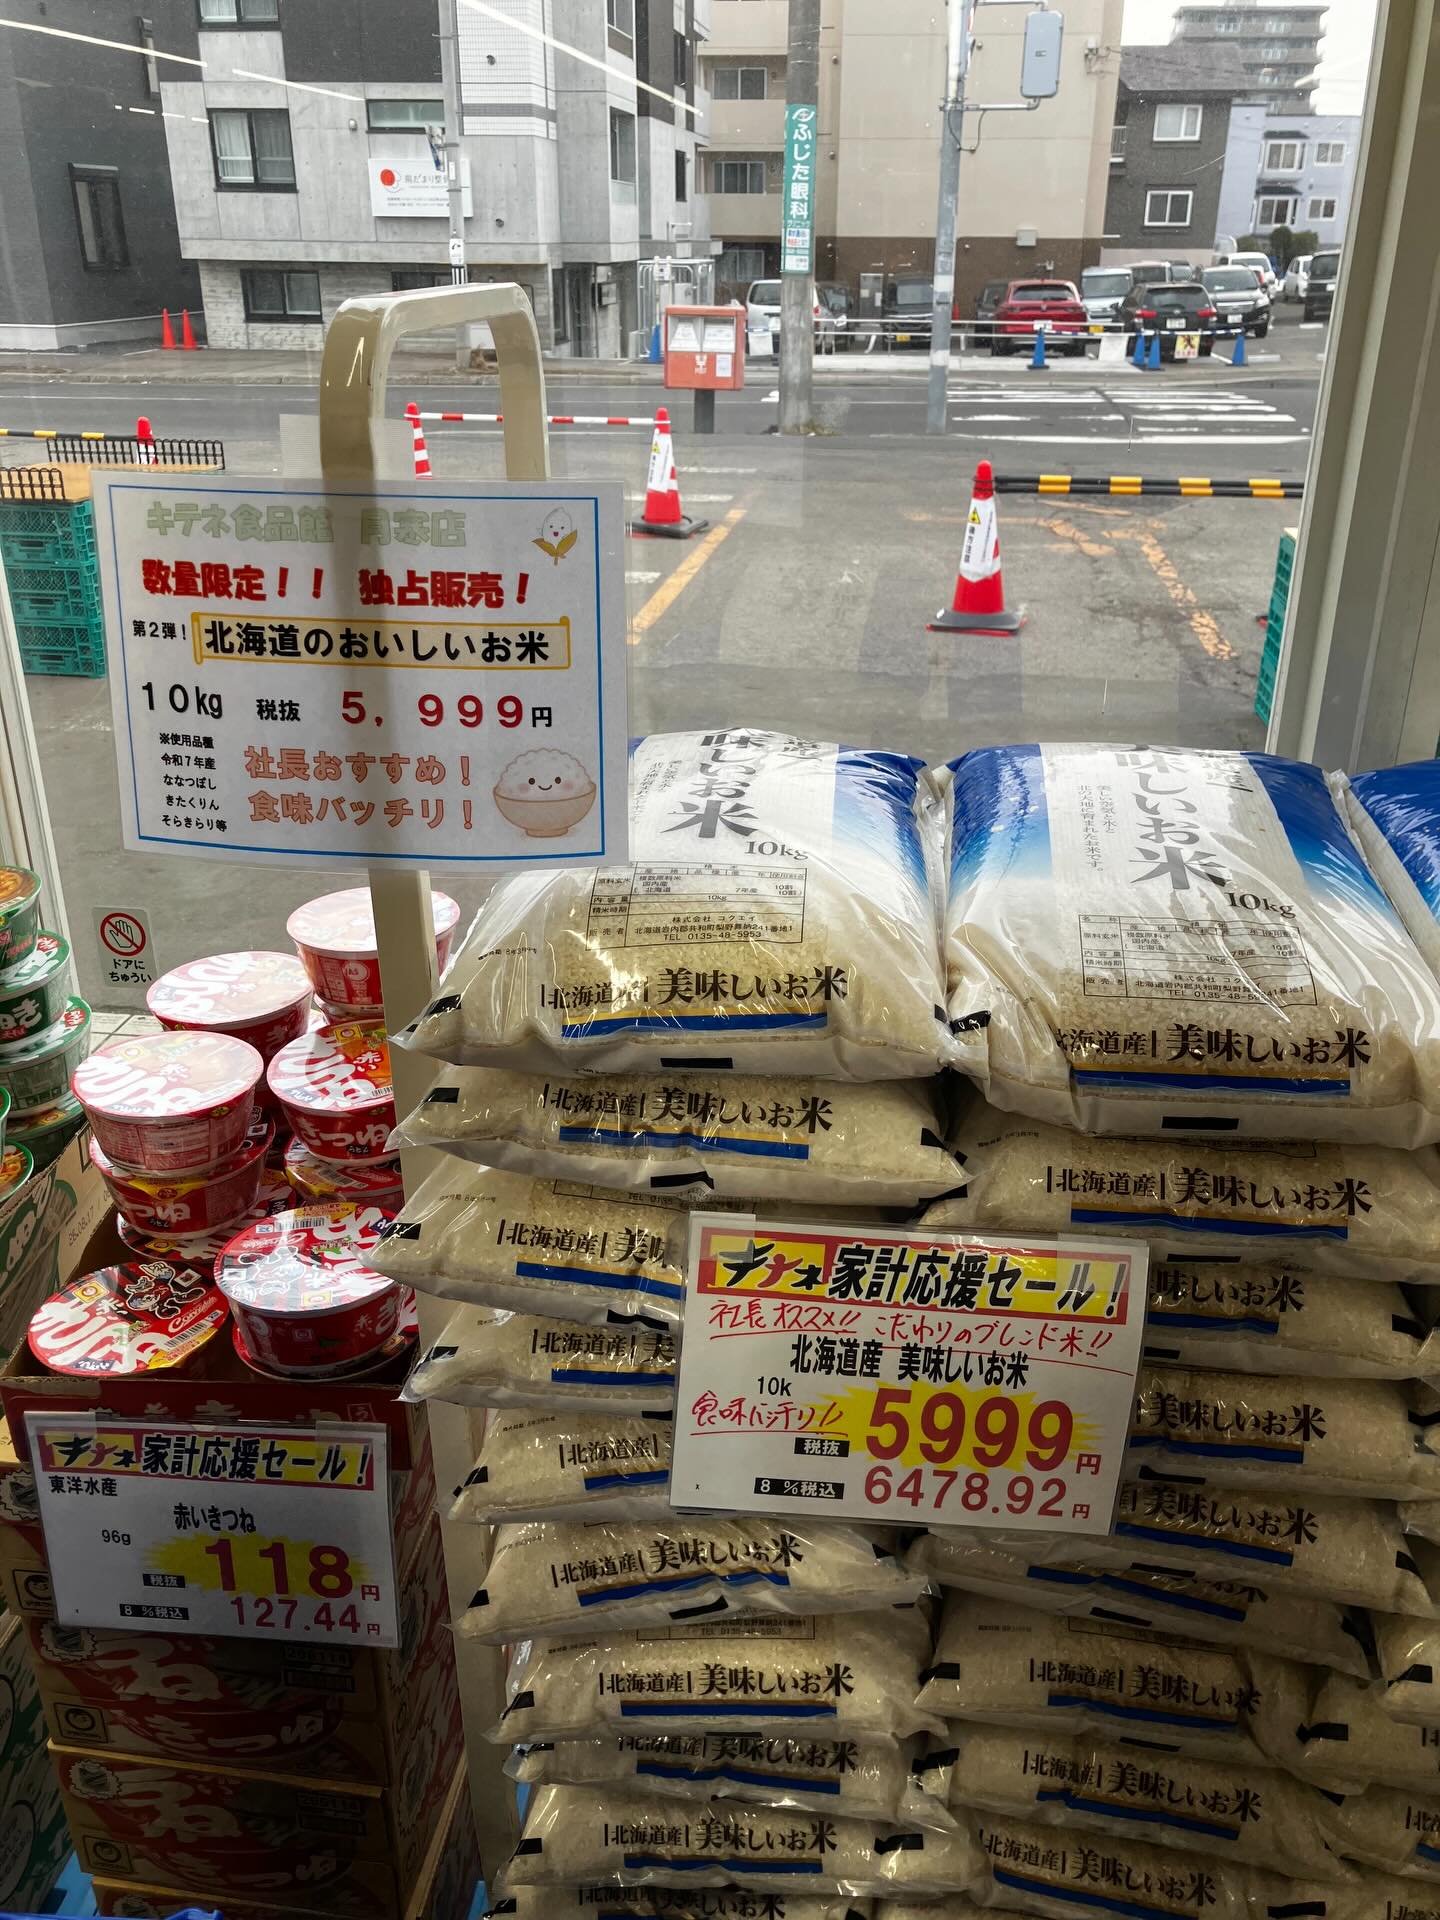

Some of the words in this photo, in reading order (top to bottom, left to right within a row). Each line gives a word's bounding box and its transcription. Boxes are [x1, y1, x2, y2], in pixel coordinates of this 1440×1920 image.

[790, 123, 812, 219] ふじた眼科
[142, 558, 324, 601] 数量限定！！
[359, 568, 530, 608] 独占販売！
[205, 620, 550, 664] 北海道のおいしいお米
[256, 697, 300, 722] 税抜
[163, 774, 217, 791] ななつぼし
[244, 745, 471, 787] 社長おすすめ！
[165, 794, 219, 811] きたくりん
[248, 789, 472, 831] 食味バッチリ！
[162, 813, 227, 832] そらきらり等
[744, 841, 808, 861] 10kg
[672, 915, 712, 923] 株式会社
[1225, 892, 1296, 919] 10kg
[663, 933, 681, 941] TEL
[687, 930, 763, 941] 0135-48-5953
[108, 971, 152, 984] ちゅうい
[112, 958, 145, 970] ドアに
[657, 967, 848, 1004] 美味しいお米
[1169, 989, 1187, 997] TEL
[1167, 1023, 1372, 1068] 美味しいお米
[553, 1088, 637, 1119] 北海道産
[652, 1086, 833, 1133] 美味しいお米
[1056, 1168, 1159, 1197] 北海道産
[1174, 1166, 1372, 1215] 美味しいお米
[506, 1222, 597, 1257] 北海道産
[1150, 1267, 1305, 1312] 味しいお米
[540, 1333, 628, 1357] 北海道産
[790, 1334, 883, 1378] 北海道産
[898, 1342, 1029, 1389] 美味しいお米
[757, 1376, 792, 1397] 10k
[1150, 1391, 1327, 1441] 美味しいお米
[803, 1439, 840, 1457] 税抜
[48, 1475, 118, 1497] 東洋水産
[173, 1502, 257, 1533] 赤いきつね
[1150, 1483, 1319, 1545] 美味しいお米
[102, 1528, 131, 1546] 96g
[560, 1555, 639, 1588] 北海道産
[650, 1534, 804, 1571] 美味しいお米
[148, 1575, 179, 1588] 税抜
[607, 1672, 685, 1694] 北海道産
[699, 1664, 855, 1697] 美味しいお米
[1036, 1660, 1117, 1691] 北海道産
[712, 1738, 859, 1771] 美味しいお米
[1110, 1761, 1262, 1822] 美味しいお米
[611, 1824, 684, 1848] 北海道産
[695, 1819, 838, 1853] 美味しいお米
[984, 1831, 1060, 1871] 北海道産
[1074, 1847, 1217, 1906] 美味しいお米
